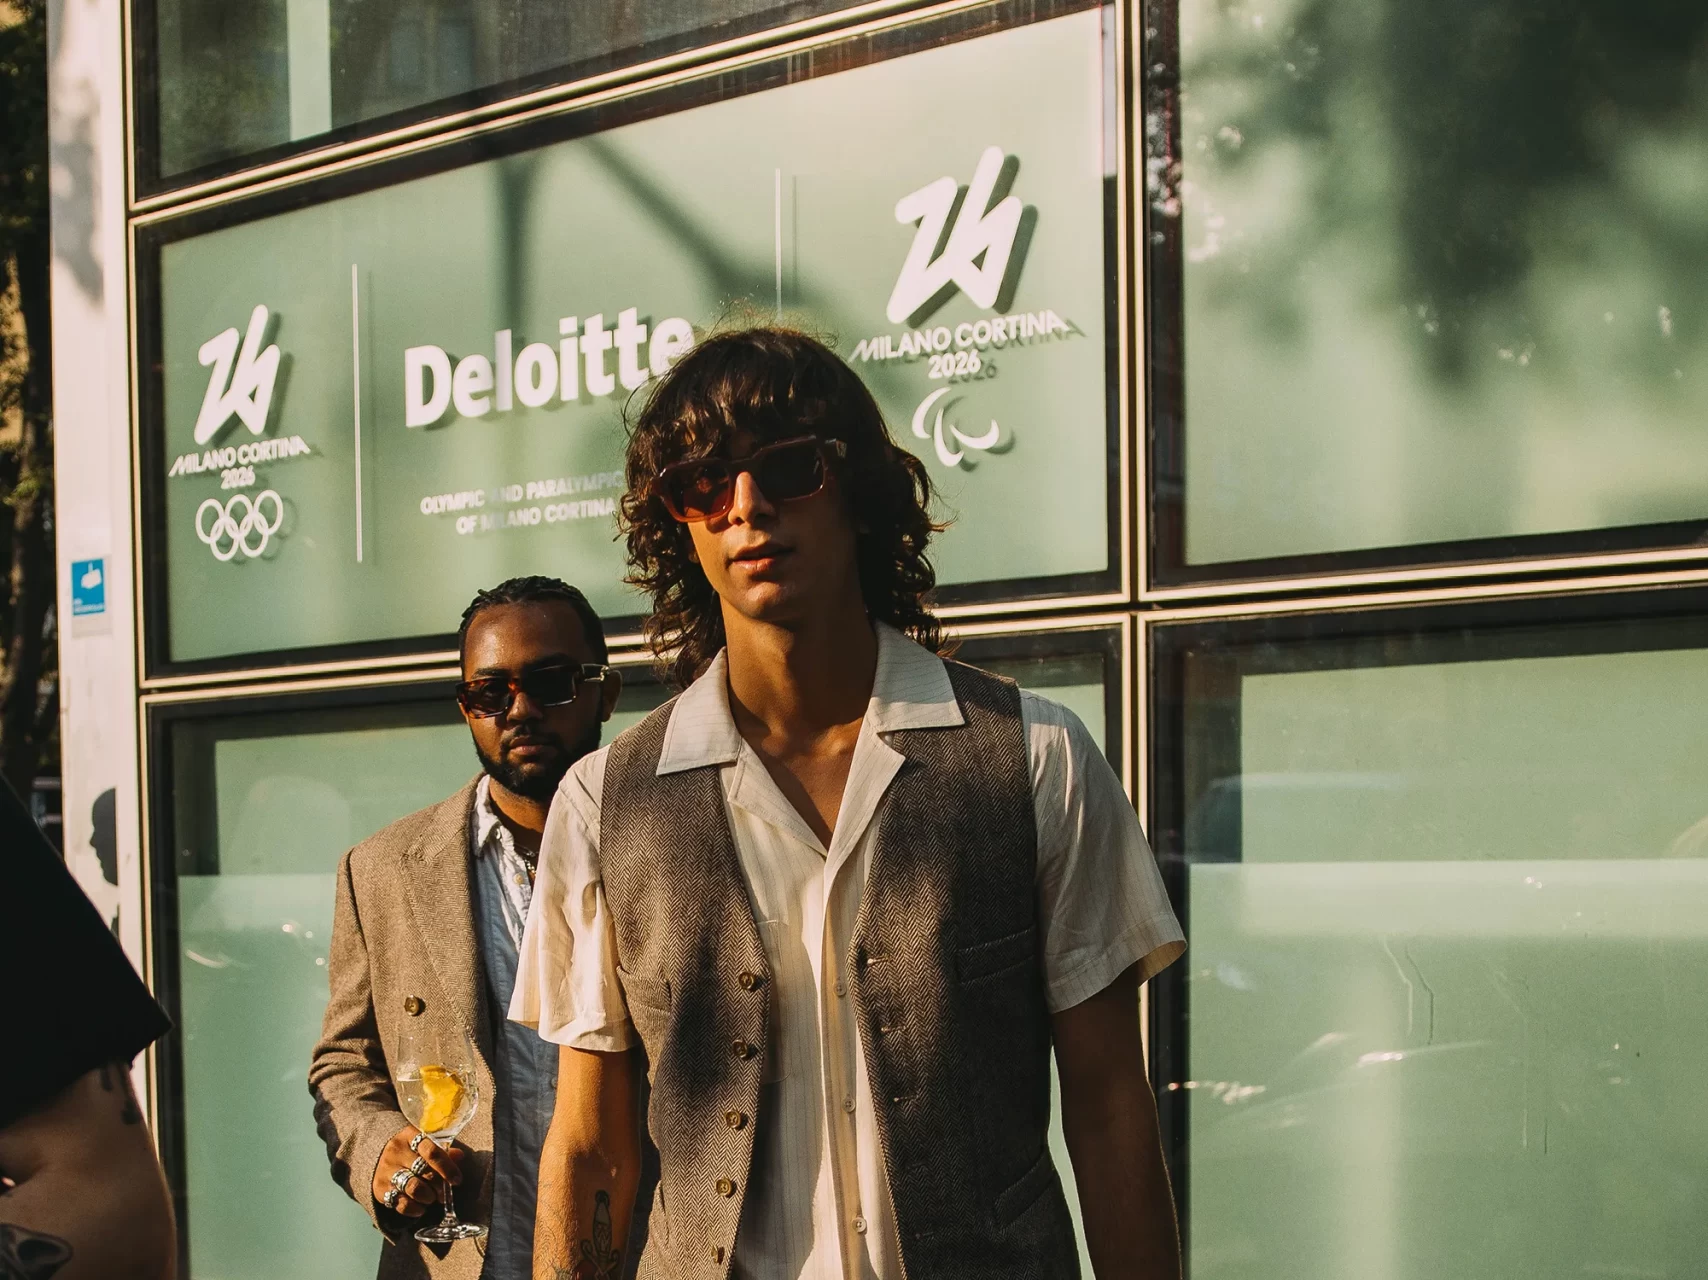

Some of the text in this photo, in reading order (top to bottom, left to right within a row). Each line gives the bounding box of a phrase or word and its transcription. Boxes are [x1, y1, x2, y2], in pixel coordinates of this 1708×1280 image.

[849, 309, 1069, 363] MILANO CORTINA
[404, 306, 697, 428] Deloitte
[928, 348, 981, 379] 2026
[168, 434, 311, 477] MILANO CORTINA
[220, 465, 256, 489] 2026
[420, 489, 486, 515] OLYMPIC
[456, 515, 477, 535] OF
[544, 497, 616, 522] CORTINA
